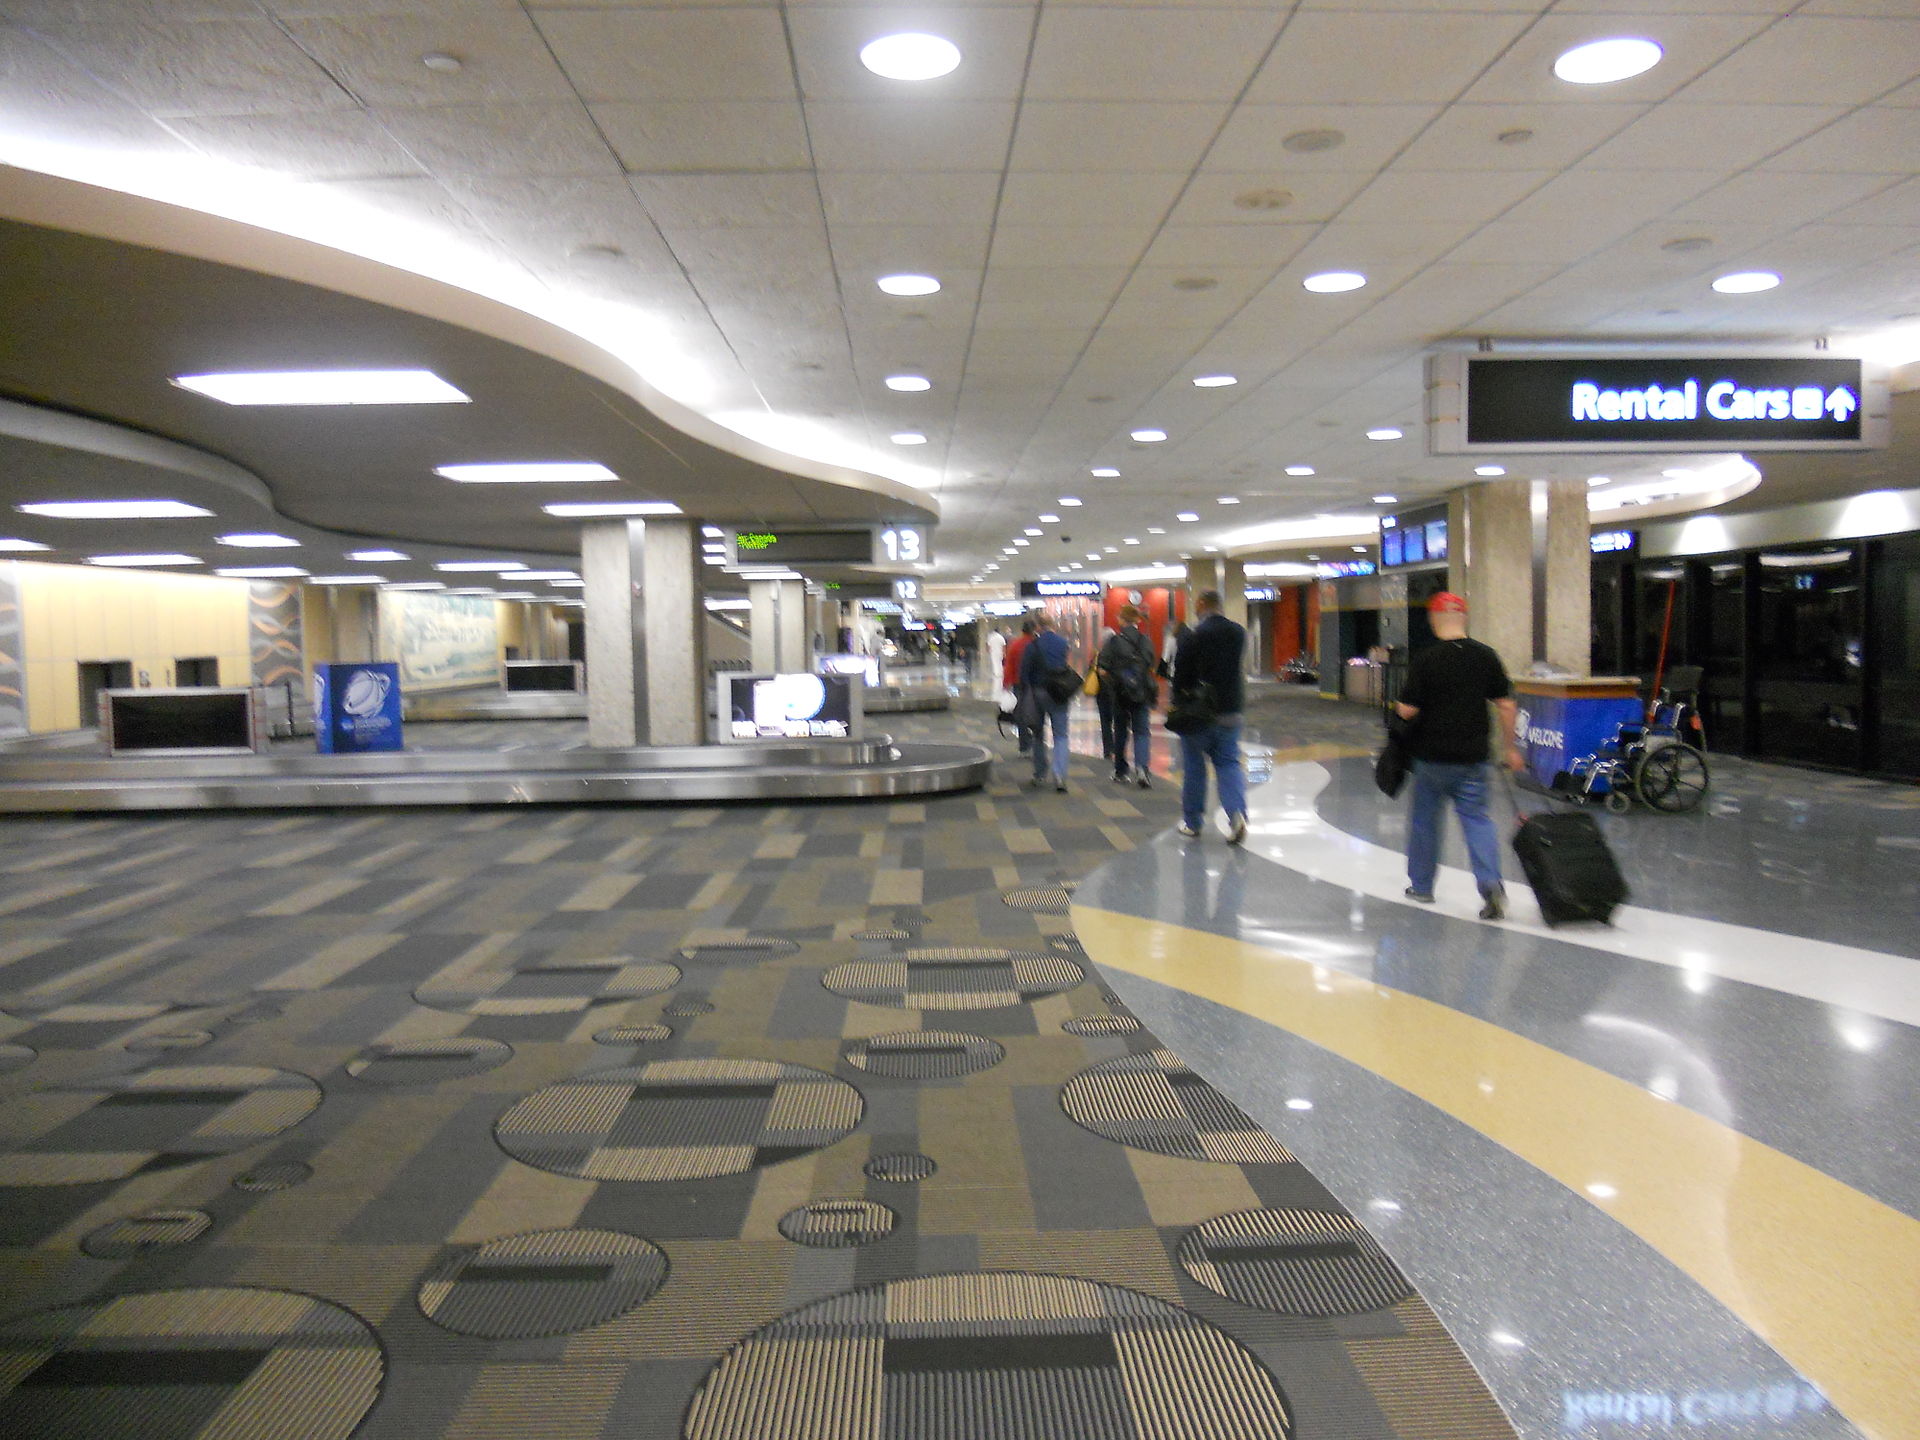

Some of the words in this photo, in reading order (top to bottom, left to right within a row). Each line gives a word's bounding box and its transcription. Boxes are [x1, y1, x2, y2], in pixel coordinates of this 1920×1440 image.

[1571, 379, 1699, 422] Rental
[1705, 382, 1791, 421] Cars
[881, 529, 921, 561] 13
[895, 580, 917, 599] 12
[1528, 727, 1563, 750] WELCOME
